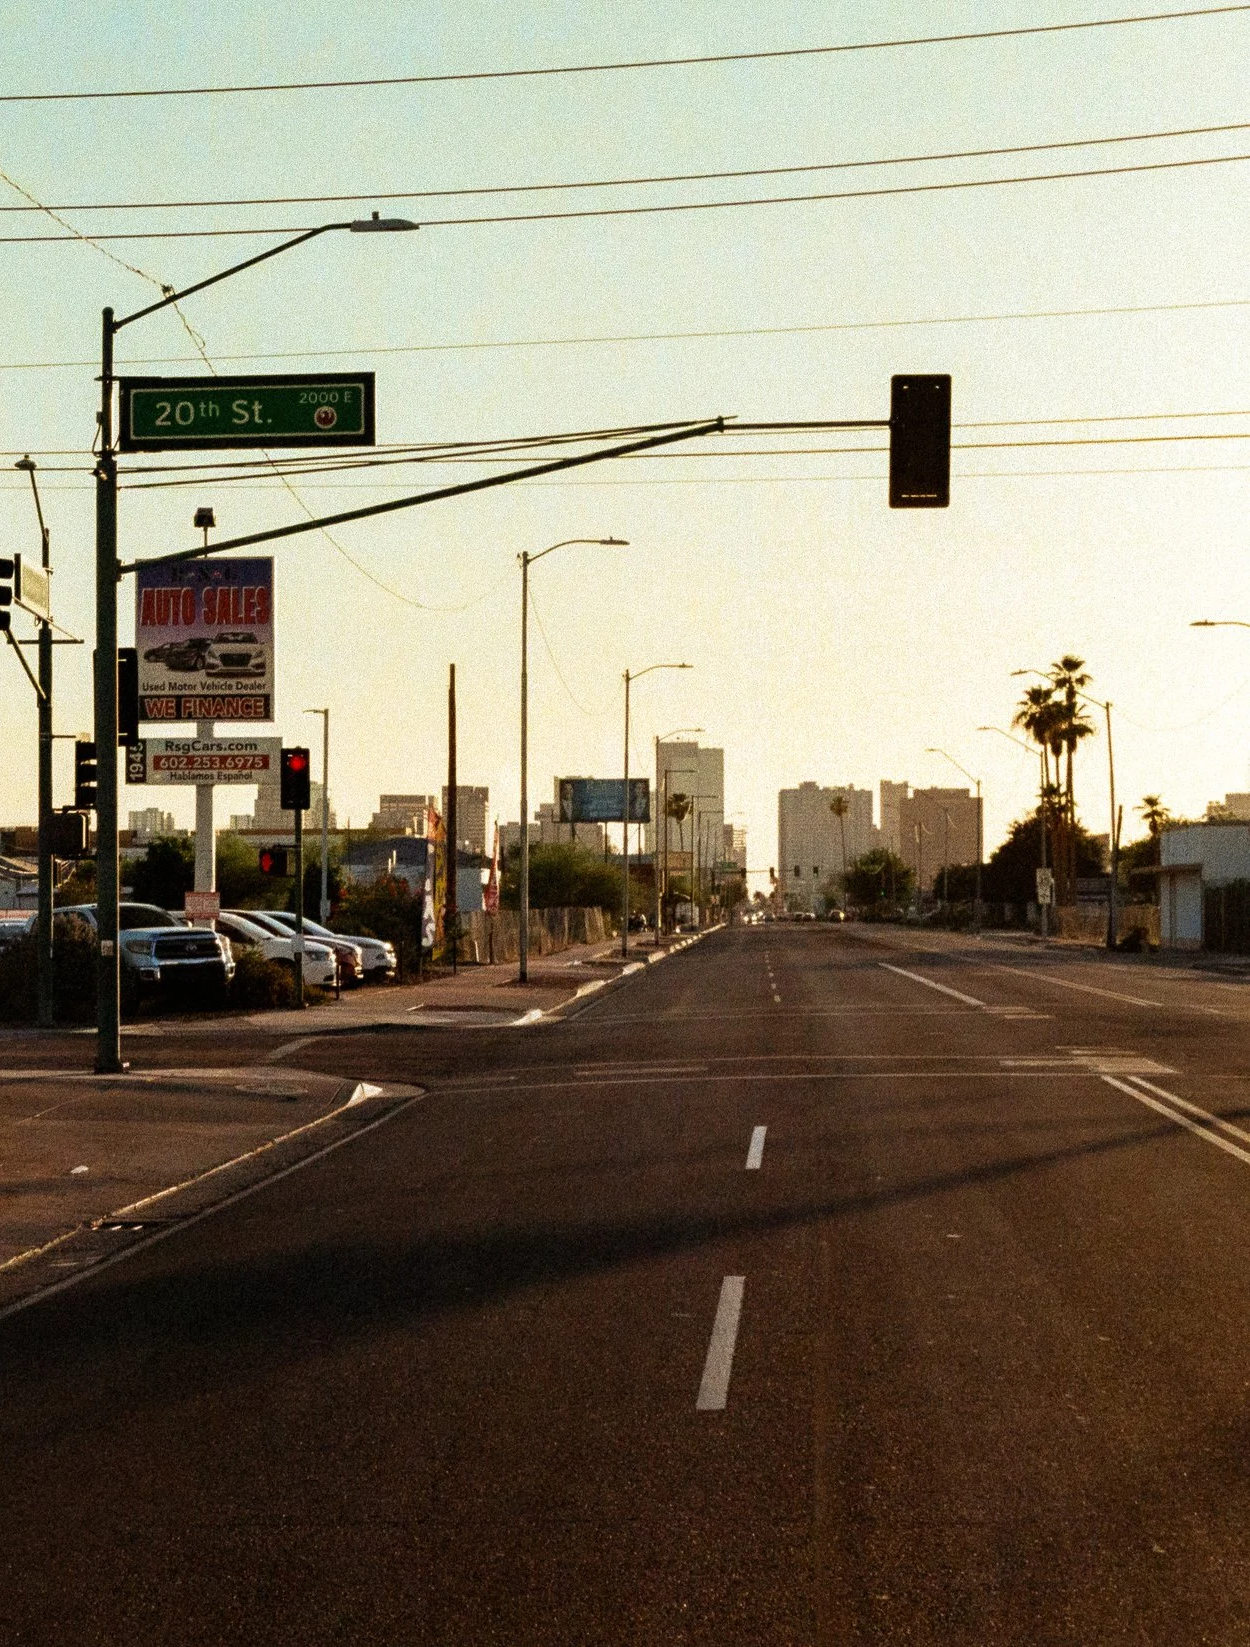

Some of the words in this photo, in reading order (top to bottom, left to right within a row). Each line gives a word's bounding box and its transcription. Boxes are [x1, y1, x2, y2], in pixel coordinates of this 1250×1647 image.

[299, 391, 339, 404] 2000
[154, 400, 220, 426] 20th
[231, 400, 273, 425] St.
[140, 587, 196, 626] AUTO
[202, 586, 270, 625] SALES
[142, 682, 165, 692] Used
[168, 681, 197, 692] Motor
[200, 681, 233, 691] Vehicle
[235, 681, 267, 691] Dealer
[145, 697, 176, 719] WE
[181, 696, 265, 718] FINANCE
[165, 741, 258, 754] RsgCars.com
[159, 756, 264, 770] 602.253.6975
[170, 771, 215, 782] Hablamos
[217, 770, 253, 782] Español
